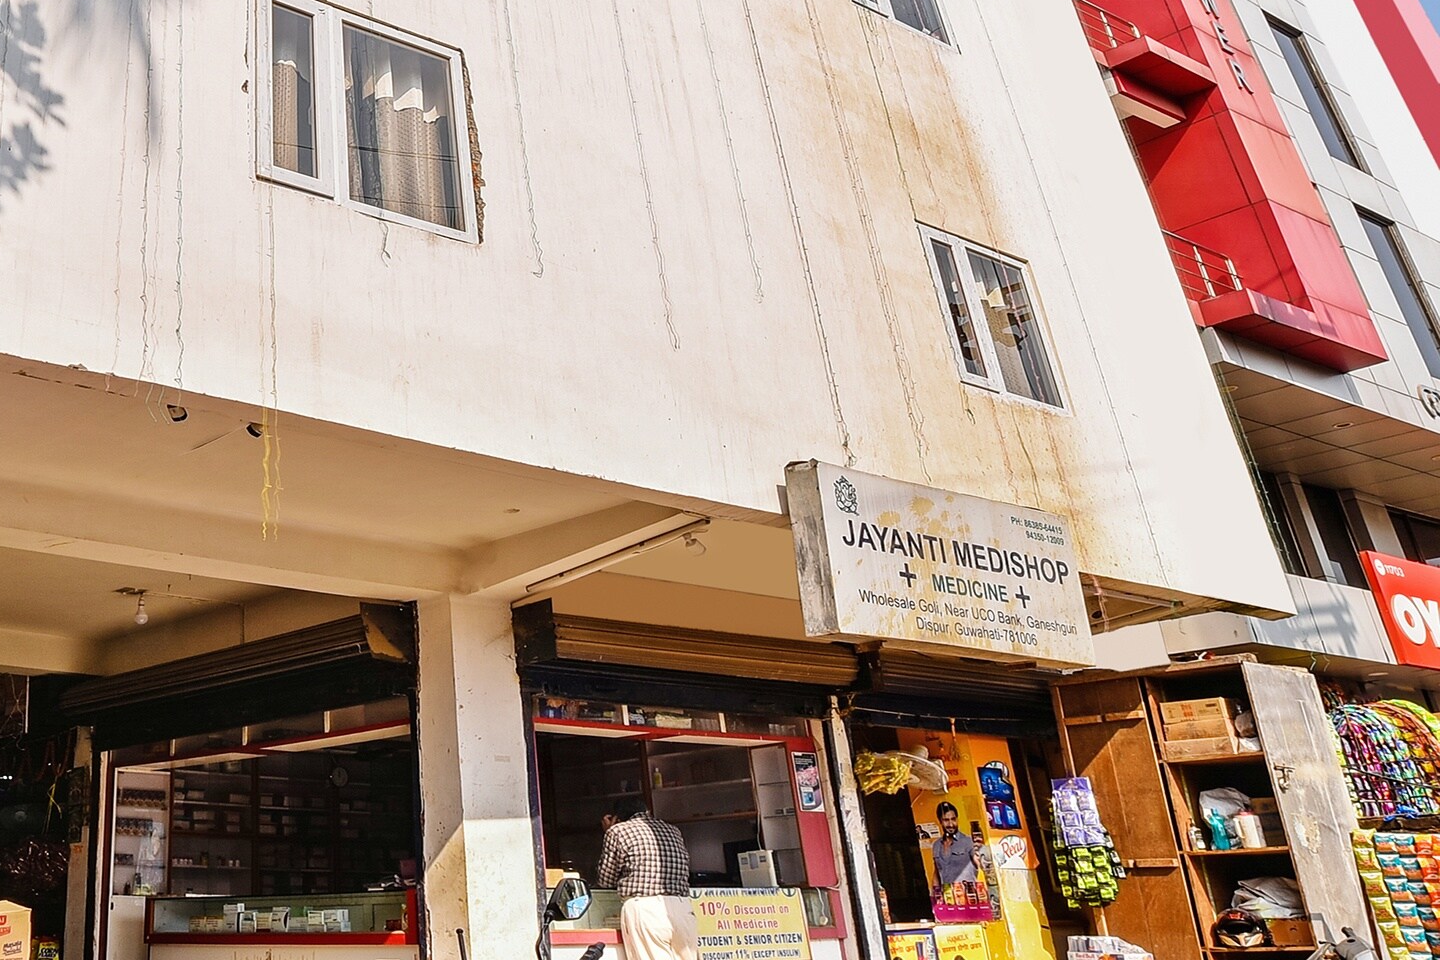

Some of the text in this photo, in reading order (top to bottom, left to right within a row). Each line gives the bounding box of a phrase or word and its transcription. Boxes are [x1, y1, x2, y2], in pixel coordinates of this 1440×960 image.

[842, 519, 1069, 585] JAYANTI MEDISHOP
[931, 573, 1009, 603] MEDICINE
[858, 588, 916, 611] Wholesale
[944, 602, 969, 619] Near
[971, 607, 995, 623] UCO
[1026, 615, 1077, 636] Ganeshguri
[954, 623, 1038, 647] Guwahati-781006
[699, 901, 790, 916] 10% Discount on
[717, 919, 779, 930] All Medicine
[698, 933, 803, 947] STUDENT & SENIOR CITIZEN
[702, 951, 734, 960] DISCOUNT
